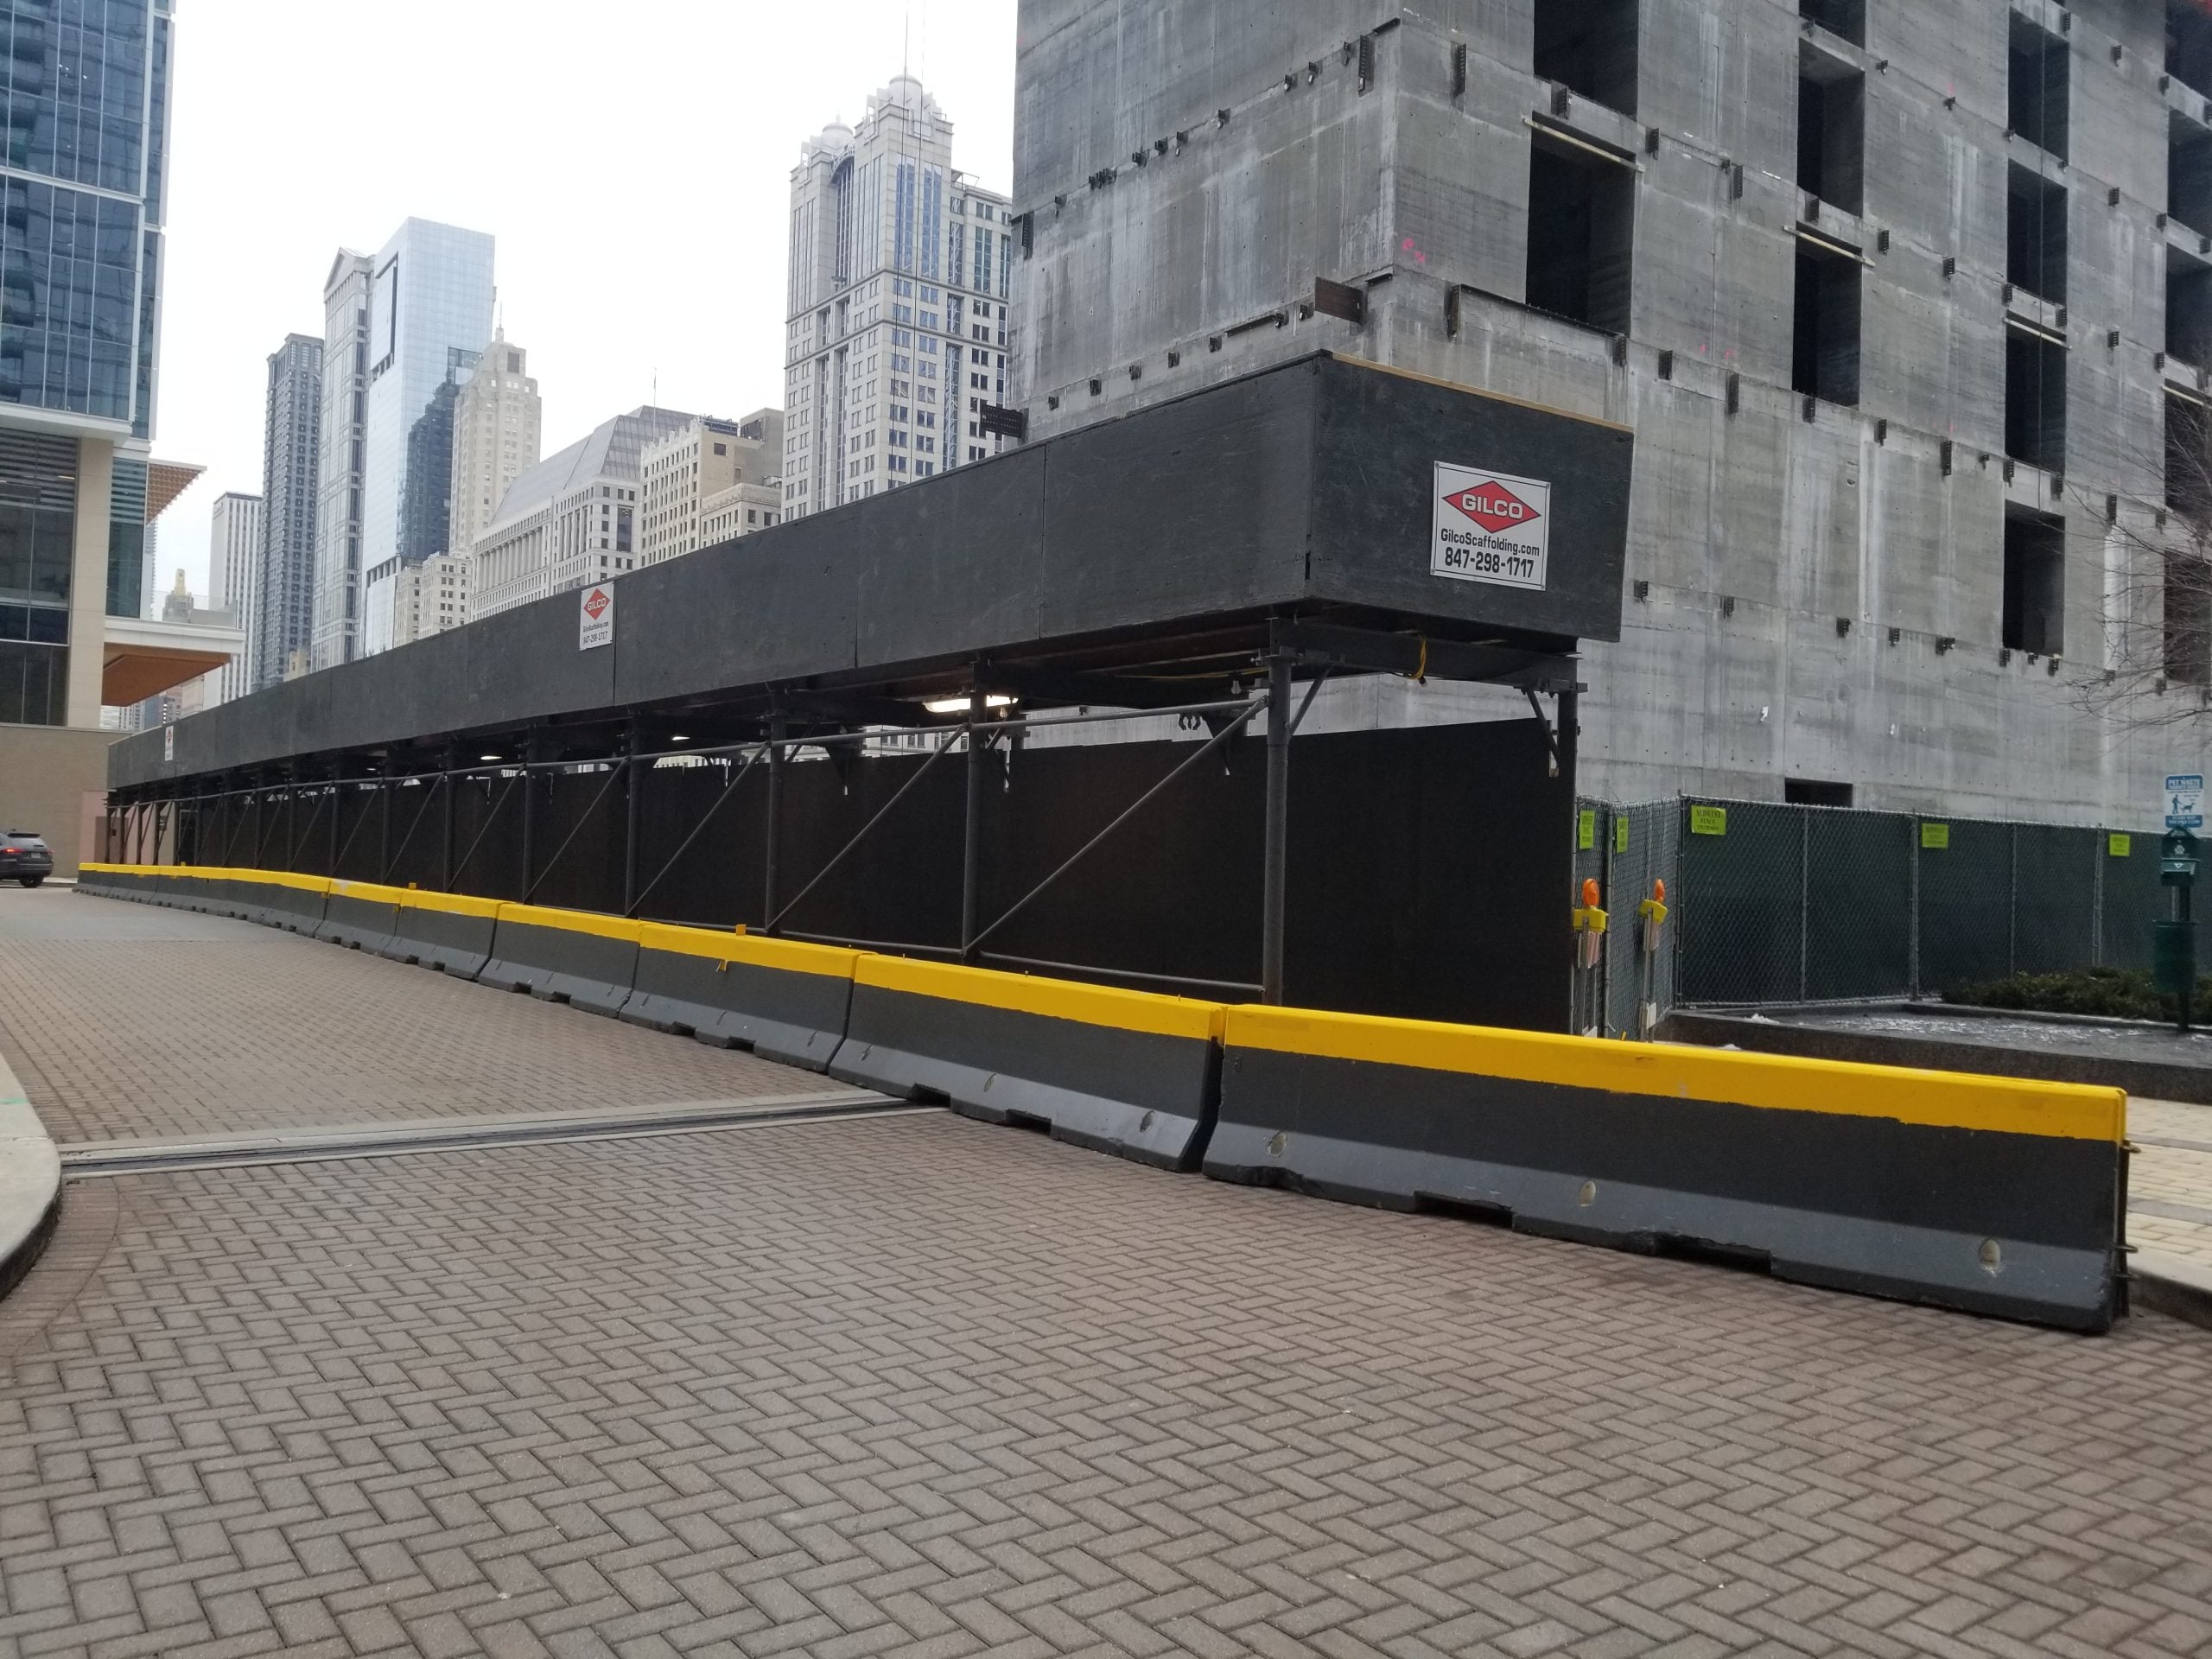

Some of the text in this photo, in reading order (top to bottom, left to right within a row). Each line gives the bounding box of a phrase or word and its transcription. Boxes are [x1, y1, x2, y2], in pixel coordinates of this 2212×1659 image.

[1461, 493, 1523, 520] GILCO
[1440, 528, 1540, 556] GilcoScaffolding.com
[1445, 546, 1535, 578] 847-298-1717
[588, 598, 607, 610] GILCO
